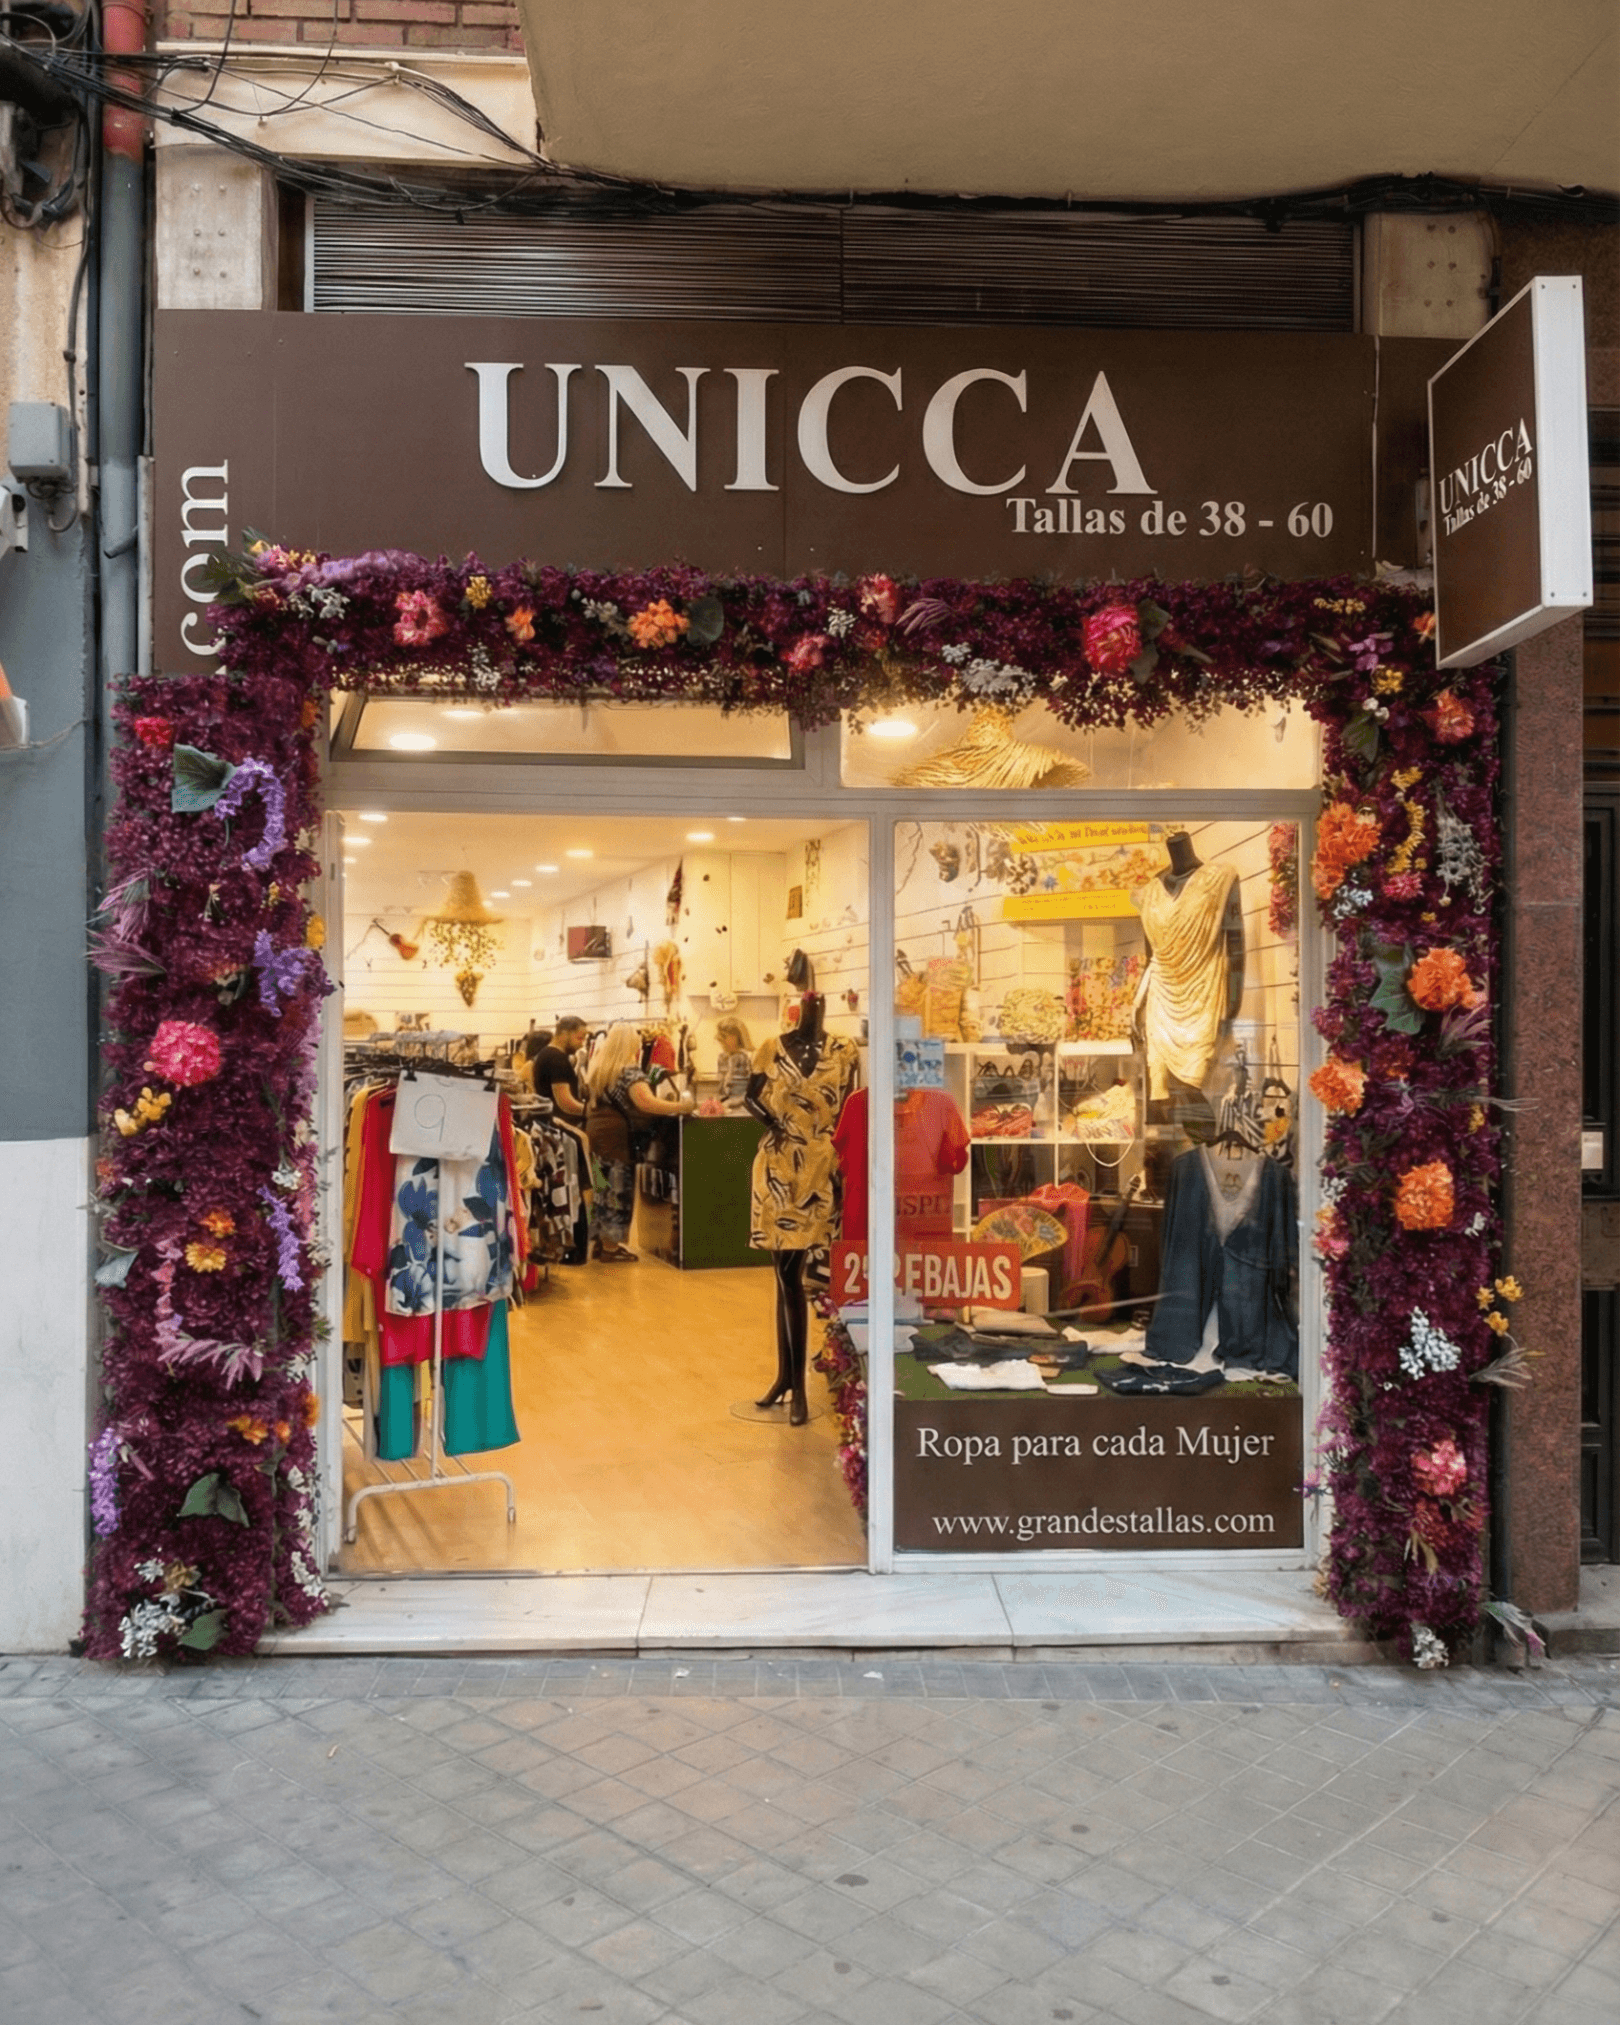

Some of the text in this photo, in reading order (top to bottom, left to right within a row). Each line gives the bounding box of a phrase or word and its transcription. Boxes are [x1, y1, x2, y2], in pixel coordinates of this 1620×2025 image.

[464, 361, 1153, 496] UNICCA
[1438, 417, 1533, 515] UNICCA
[1006, 498, 1334, 538] Tallas de 38 - 60
[916, 1425, 1275, 1465] Ropa para cada Mujer
[932, 1506, 1276, 1542] www.grandestallas.com
